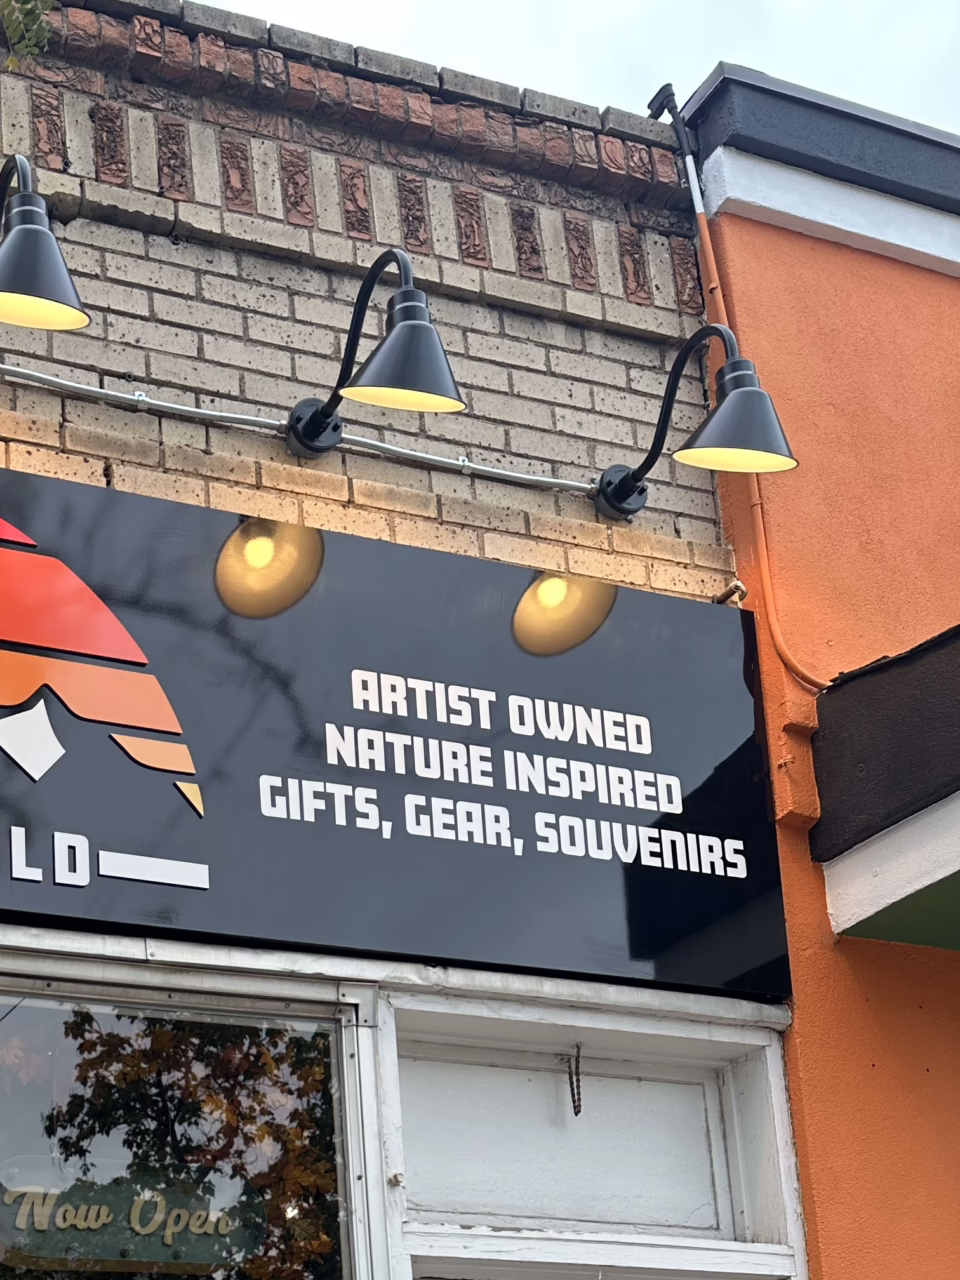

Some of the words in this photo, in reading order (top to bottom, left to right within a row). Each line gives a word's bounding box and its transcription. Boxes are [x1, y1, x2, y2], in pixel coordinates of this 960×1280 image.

[351, 669, 497, 731] ARTIST
[508, 694, 653, 756] OWNED
[325, 722, 493, 788] NATURE
[503, 750, 683, 815] INSPIRED
[259, 773, 393, 840] GIFTS,
[404, 794, 525, 856] GEAR,
[535, 812, 748, 880] SOUVENIRS
[3, 1184, 115, 1231] Now
[130, 1189, 234, 1246] Open
